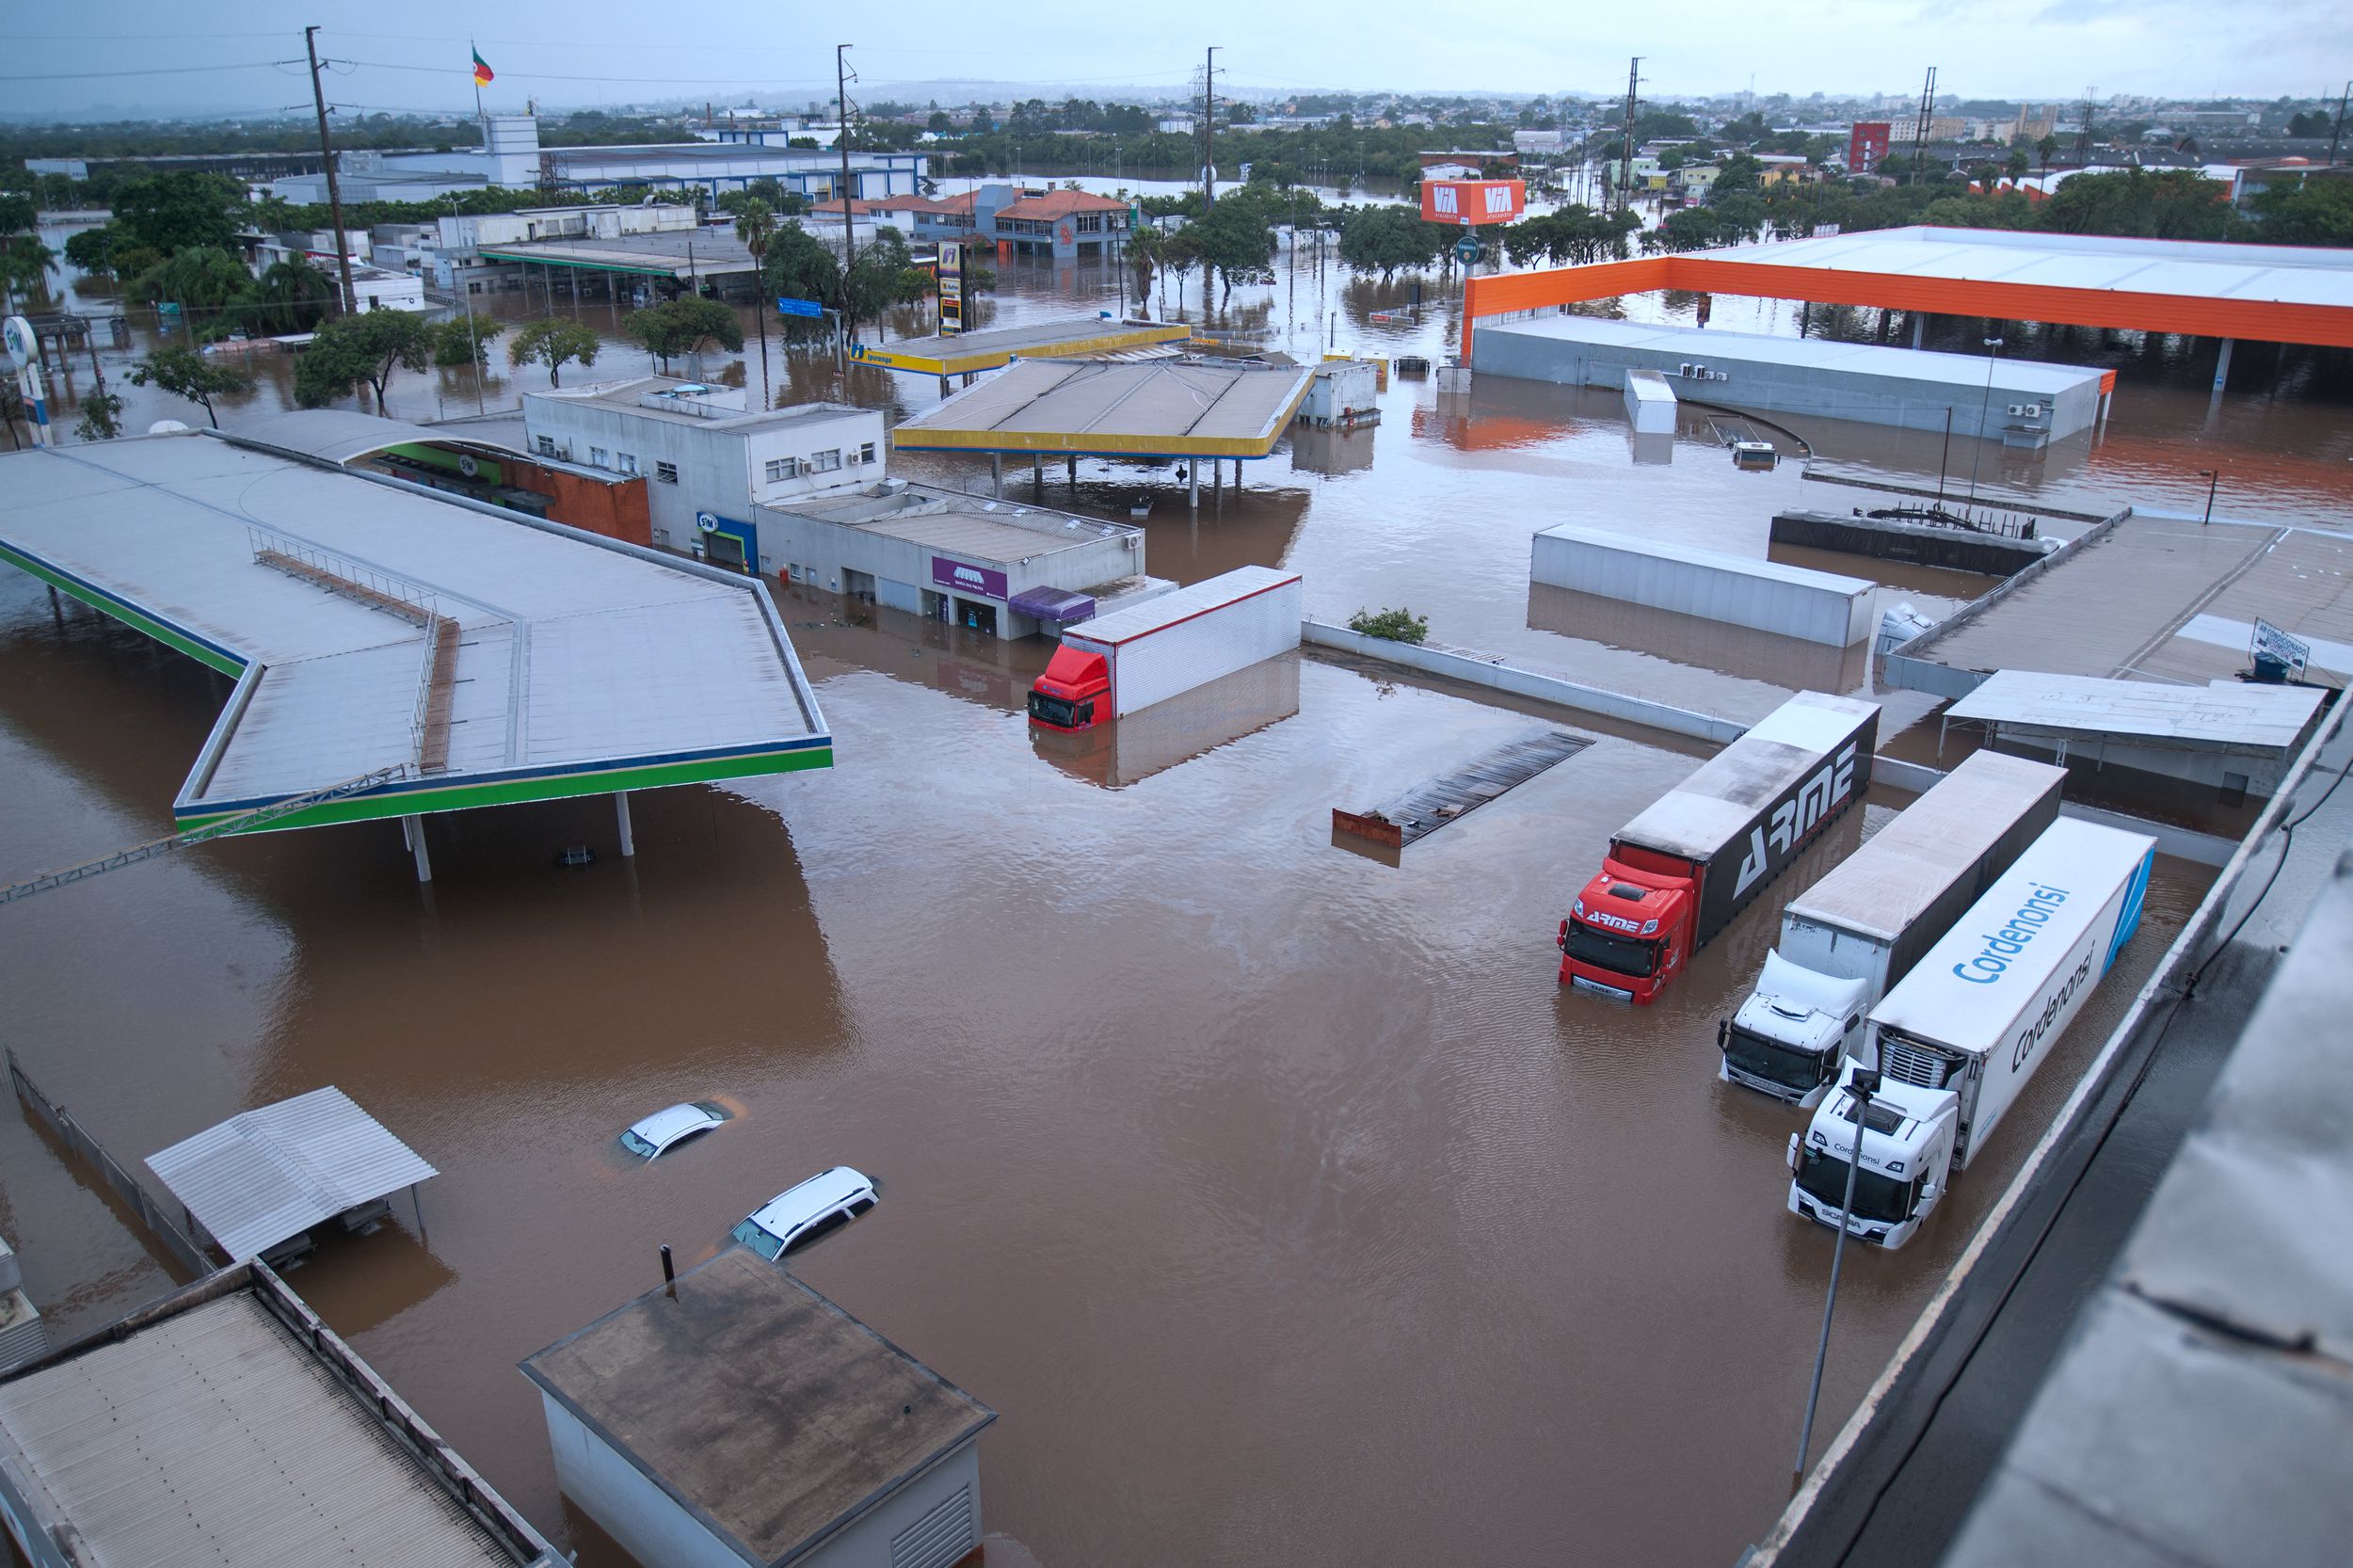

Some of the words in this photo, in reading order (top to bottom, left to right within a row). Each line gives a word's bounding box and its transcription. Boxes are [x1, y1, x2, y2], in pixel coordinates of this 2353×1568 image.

[2267, 629, 2307, 657] CONDICIONADO
[1733, 741, 1857, 901] ARME
[1587, 910, 1641, 933] ARME
[1952, 882, 2070, 984] Cordenonsi
[1591, 984, 1612, 994] DAF
[2011, 939, 2096, 1074] Cordenonsi
[1833, 1143, 1881, 1165] Cordnonsi
[1821, 1208, 1862, 1229] SCAIA
